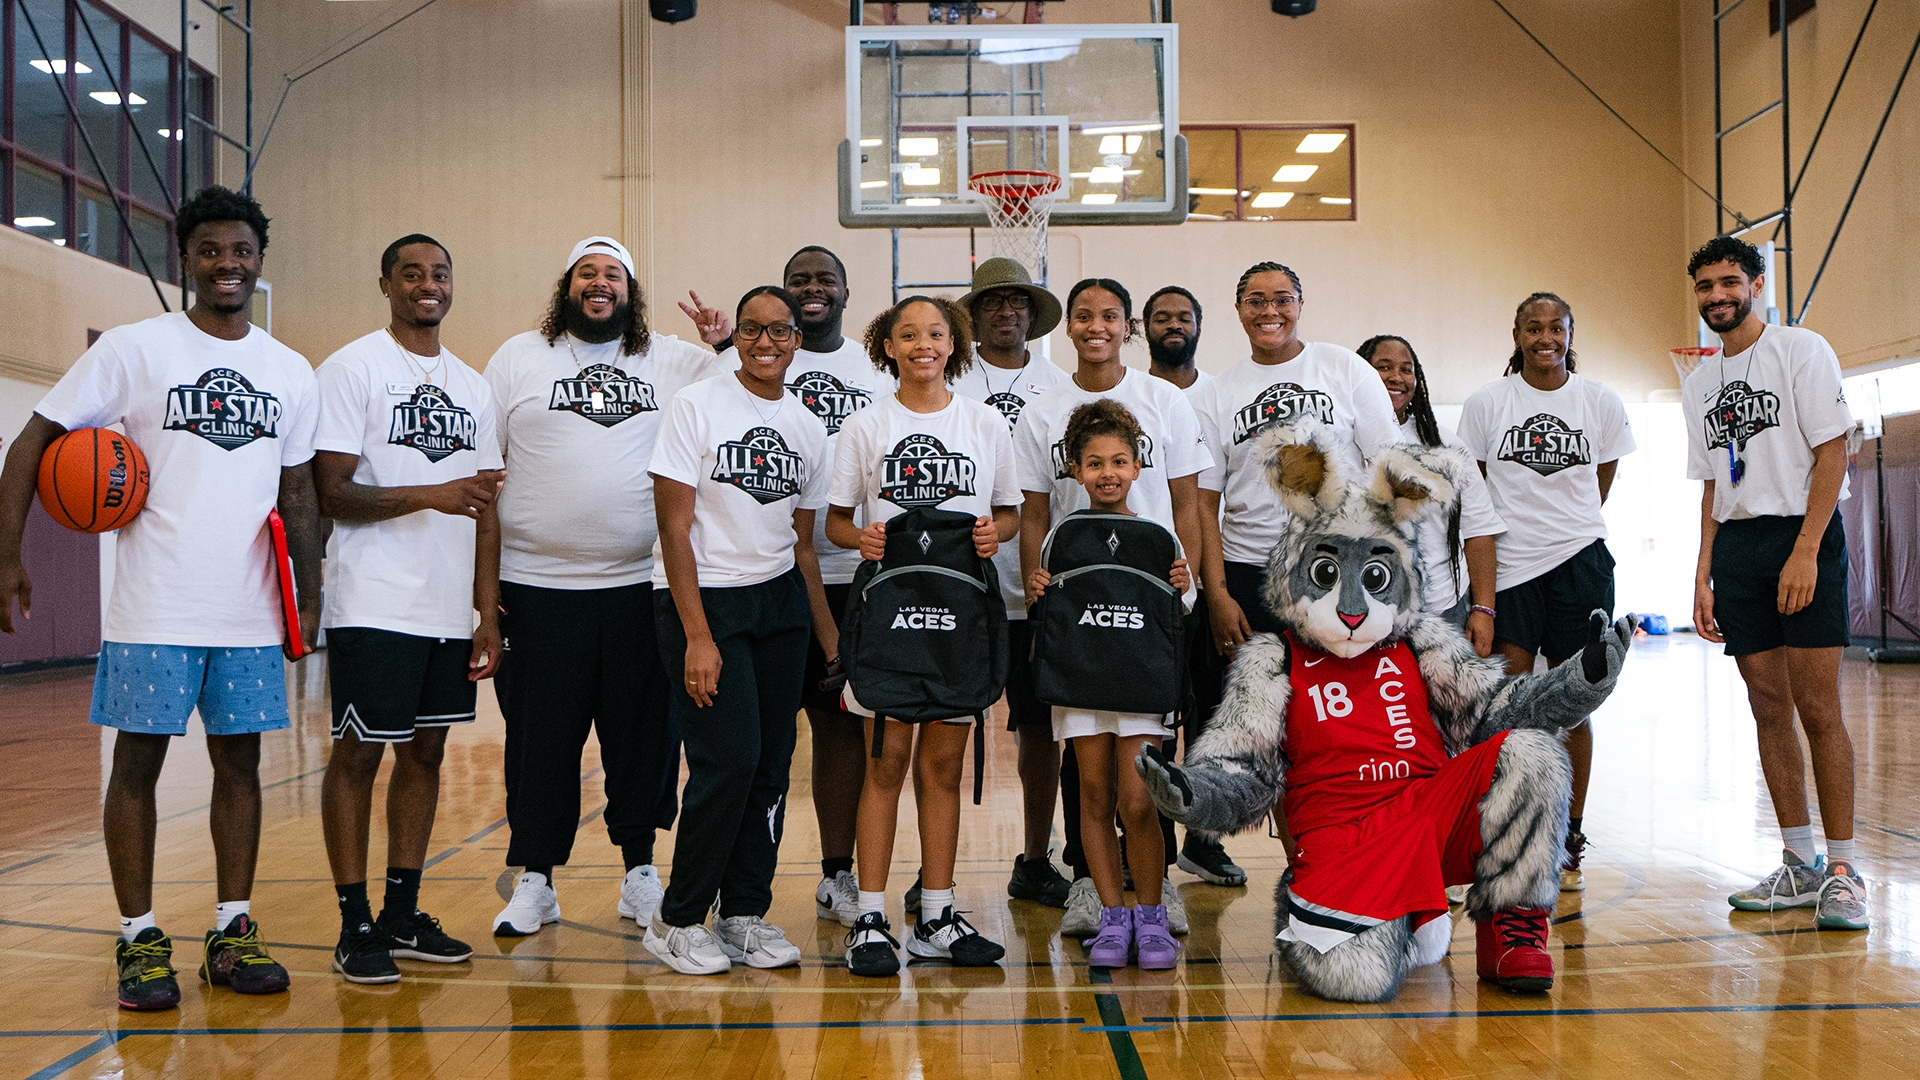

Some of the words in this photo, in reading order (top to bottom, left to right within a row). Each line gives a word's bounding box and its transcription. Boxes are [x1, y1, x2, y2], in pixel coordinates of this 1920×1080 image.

[210, 369, 241, 381] ACES
[588, 364, 615, 373] ACES
[805, 373, 833, 382] ACES
[418, 386, 443, 396] ACES
[551, 382, 593, 408] ALL
[603, 381, 657, 409] STAR
[1266, 383, 1293, 394] ACES
[1724, 382, 1745, 394] ACES
[165, 391, 216, 428] ALL
[225, 394, 281, 433] STAR
[1234, 404, 1270, 442] ALL
[1277, 394, 1333, 423] STAR
[1533, 414, 1559, 423] ACES
[198, 421, 255, 436] CLINIC
[390, 408, 425, 442] ALL
[428, 410, 476, 448] STAR
[1704, 410, 1729, 448] ALL
[1735, 395, 1778, 426] STAR
[413, 434, 454, 449] CLINIC
[753, 428, 780, 440] ACES
[904, 435, 935, 446] ACES
[1500, 430, 1536, 458] ALL
[1545, 432, 1590, 462] STAR
[1522, 453, 1569, 465] CLINIC
[103, 440, 127, 508] Wilson
[712, 446, 758, 478] ALL
[766, 451, 805, 489] STAR
[742, 475, 791, 493] CLINIC
[881, 460, 908, 488] LL
[917, 458, 974, 494] STAR
[892, 486, 946, 500] CLINIC
[1108, 604, 1138, 612] VEGAS
[890, 613, 957, 630] ACES
[1078, 610, 1144, 629] ACES
[1307, 681, 1353, 722] 18
[1374, 656, 1416, 749] ACES
